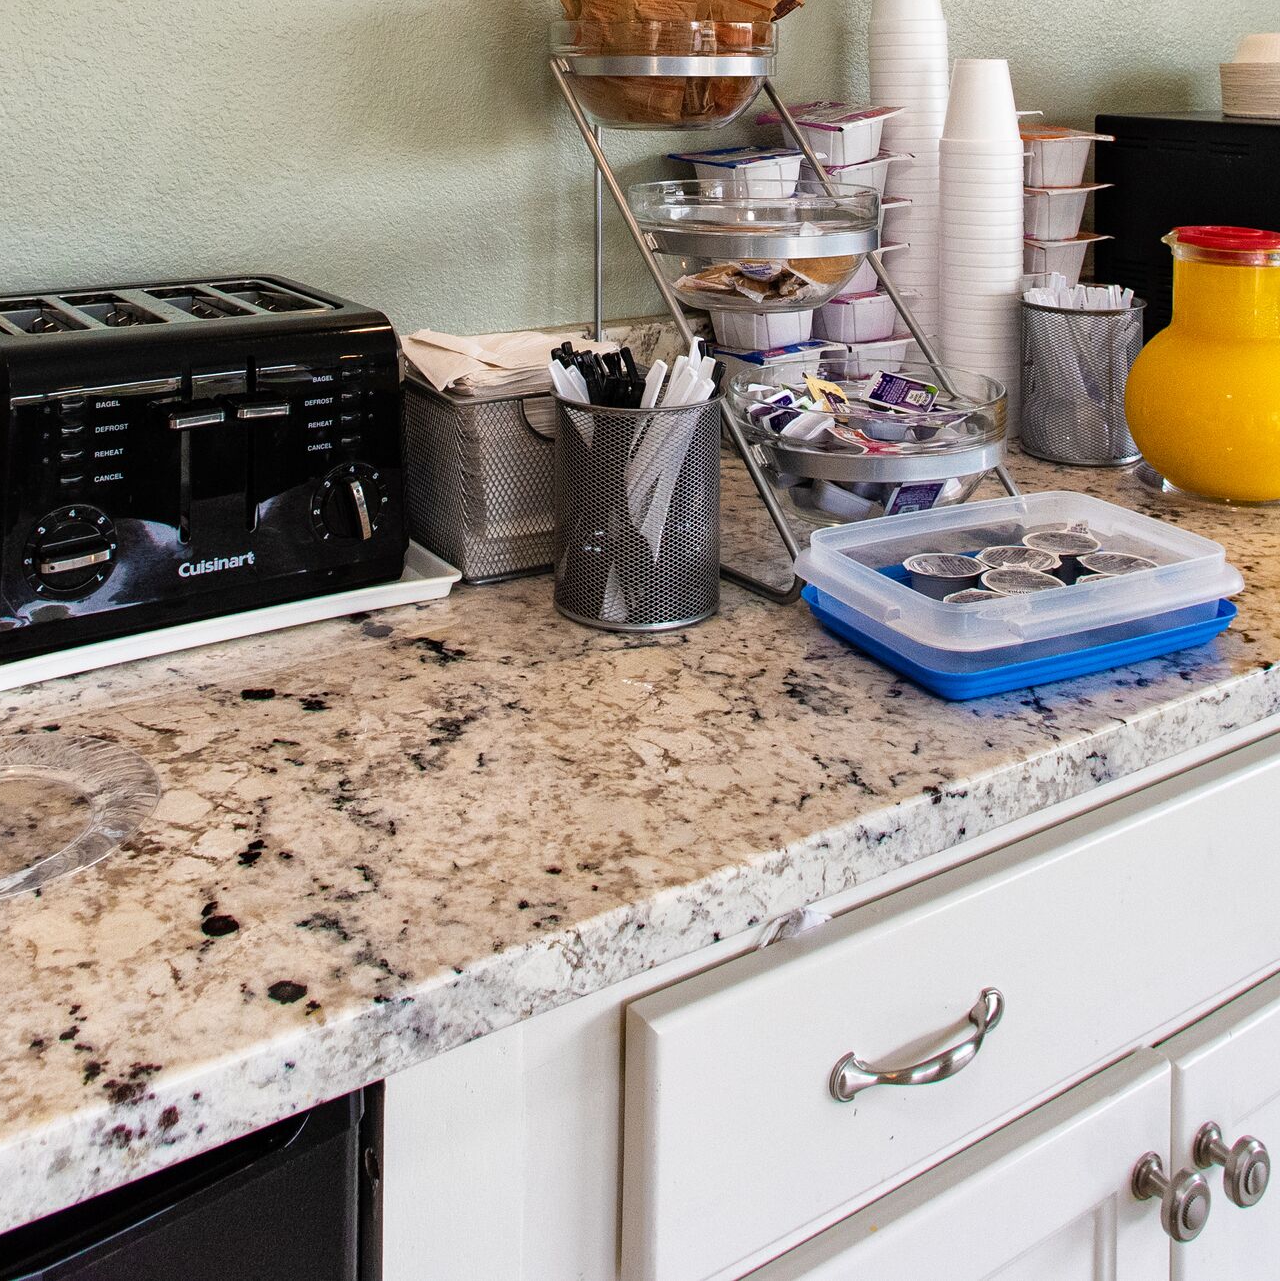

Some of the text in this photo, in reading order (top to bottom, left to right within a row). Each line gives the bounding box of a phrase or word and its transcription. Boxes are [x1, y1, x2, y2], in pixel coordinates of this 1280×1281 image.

[312, 375, 334, 383] BAGEL
[95, 400, 121, 409] BAGEL
[304, 397, 333, 407] DEFROST
[95, 423, 129, 434] DEFROST
[308, 419, 333, 429] REHEAT
[307, 442, 333, 452] CANCEL
[94, 448, 124, 458] REHEAT
[94, 472, 124, 483] CANCEL
[178, 550, 256, 578] Cuisinart
